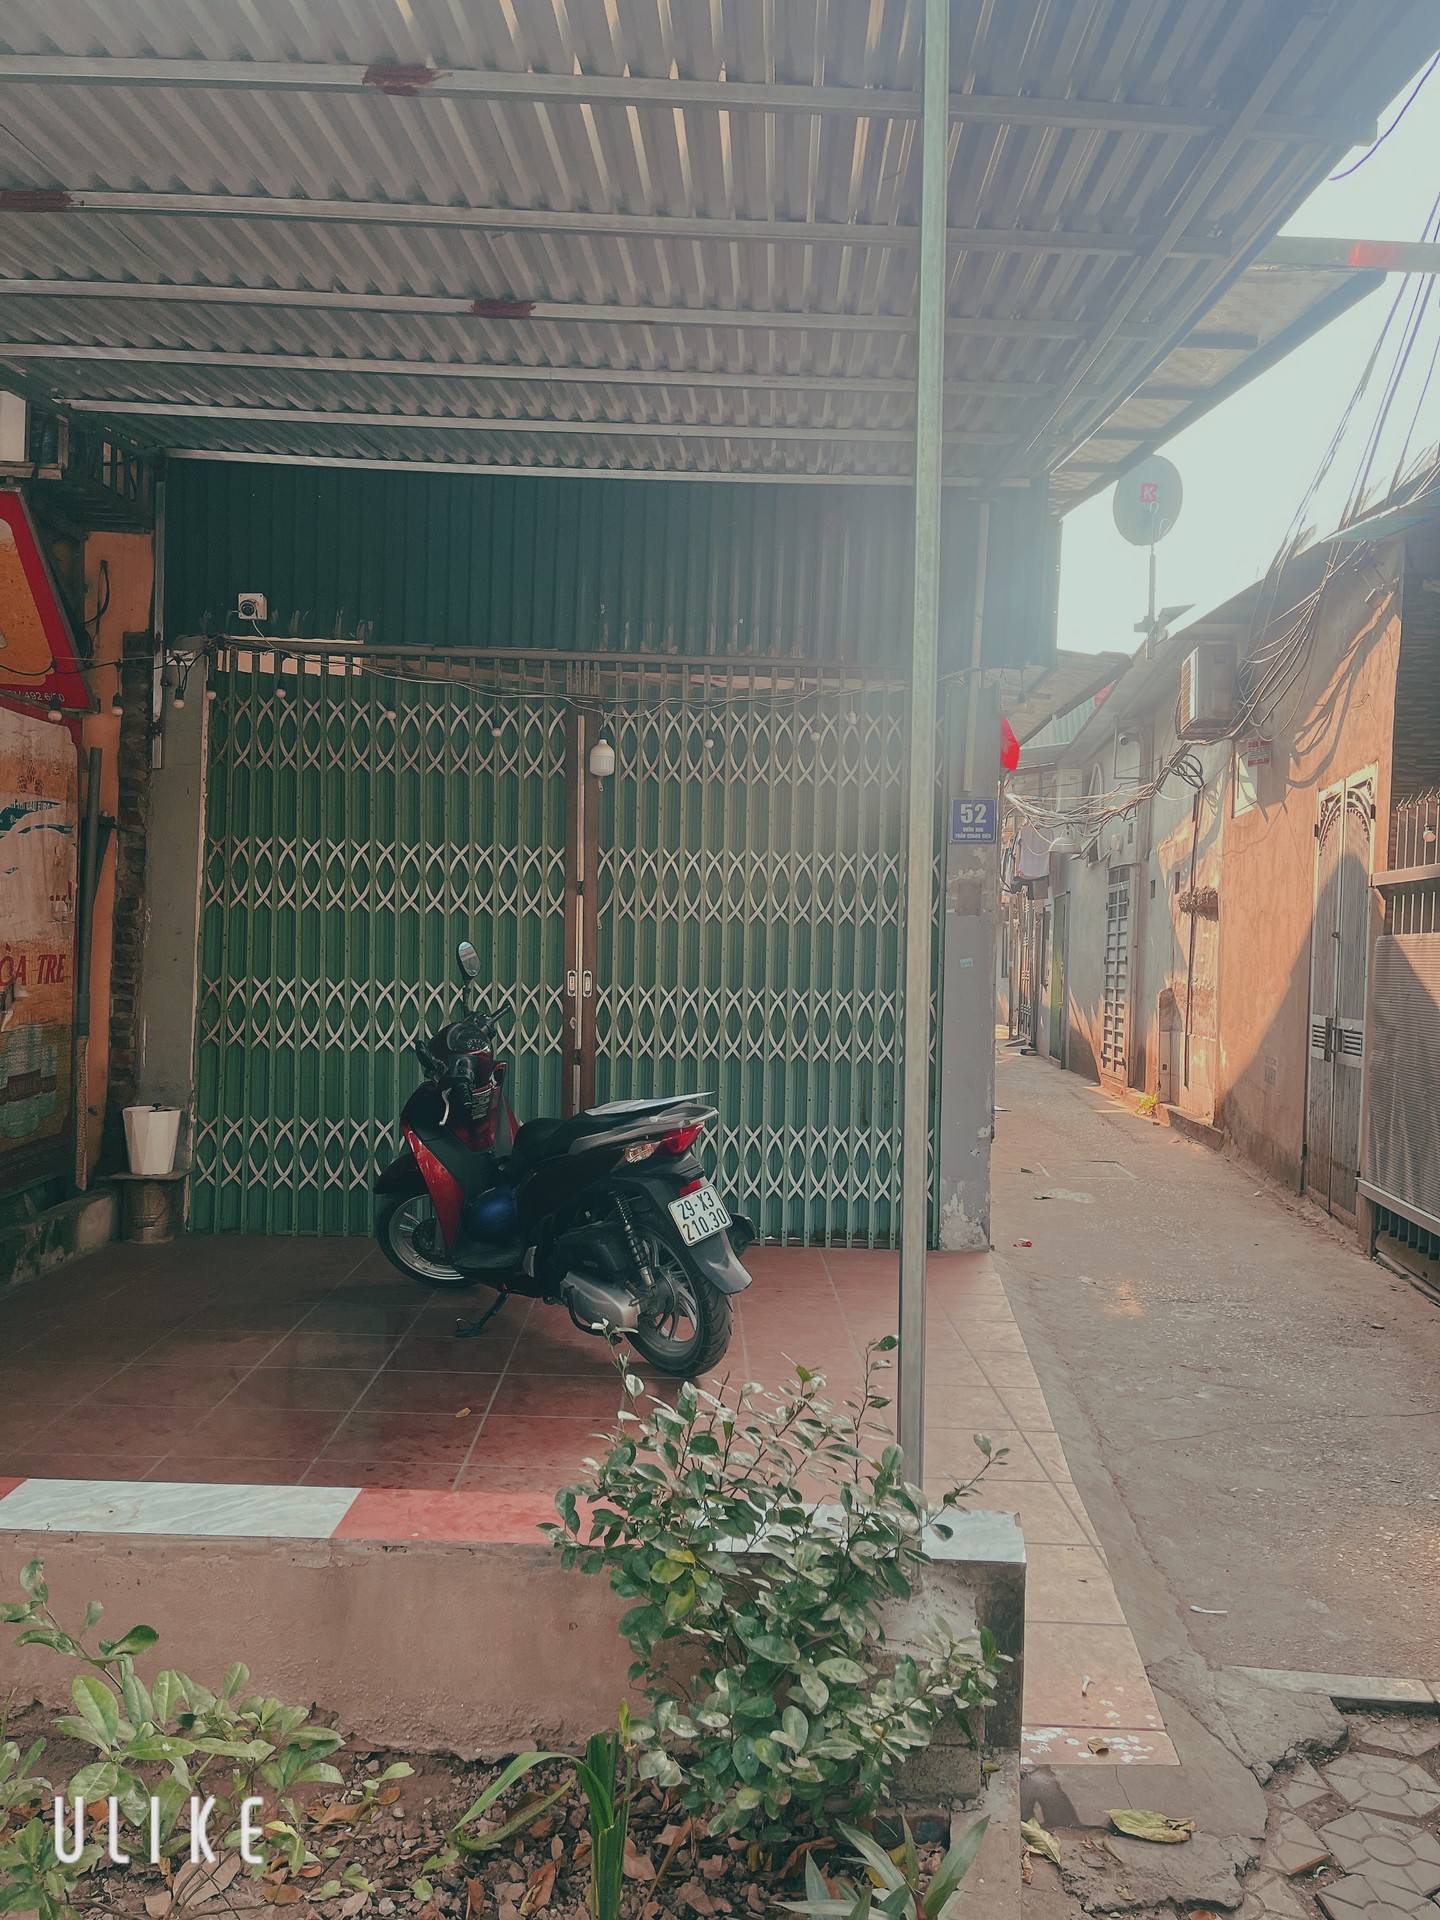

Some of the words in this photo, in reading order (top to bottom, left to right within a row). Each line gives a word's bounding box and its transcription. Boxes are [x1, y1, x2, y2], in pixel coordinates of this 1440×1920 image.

[960, 803, 987, 824] 52
[37, 953, 67, 985] TRE
[677, 1191, 715, 1221] 29-X3
[682, 1207, 728, 1242] 210.30
